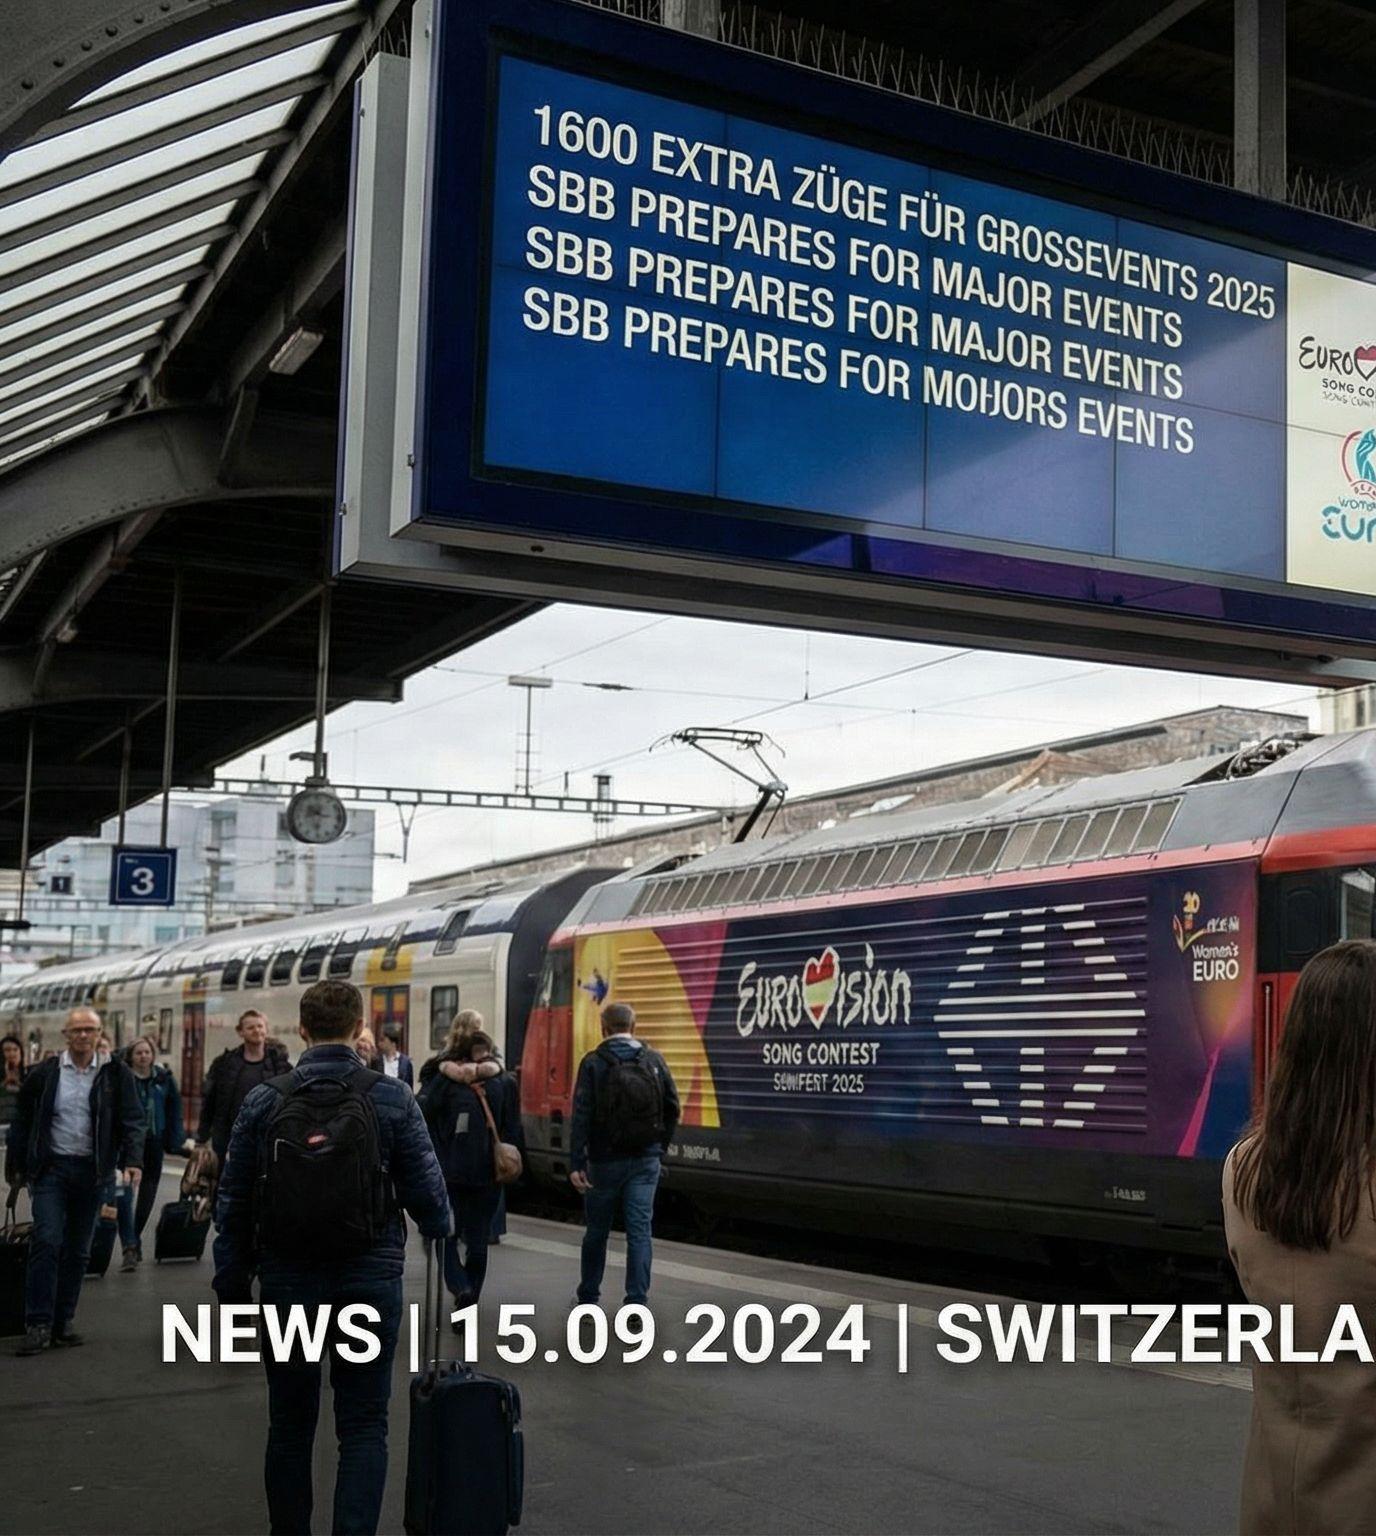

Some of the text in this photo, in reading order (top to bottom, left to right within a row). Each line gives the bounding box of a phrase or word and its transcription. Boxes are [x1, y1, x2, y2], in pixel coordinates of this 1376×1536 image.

[534, 105, 1275, 320] 1600 EXTRA ZÜGE FÜR GROSSEVENTS 2025
[528, 164, 1183, 348] SBB PREPARES FOR MAJOR EVENTS
[526, 226, 1184, 400] SBB PREPARES FOR MAJOR EVENTS
[523, 286, 609, 342] SBB
[624, 306, 827, 384] PREPARES
[840, 349, 910, 400] FOR
[1078, 397, 1194, 454] EVENTS
[1322, 378, 1354, 394] SONG
[131, 867, 154, 895] 3
[1193, 959, 1239, 981] EURO
[762, 1042, 880, 1065] SONG CONTEST
[832, 1073, 865, 1093] 2025
